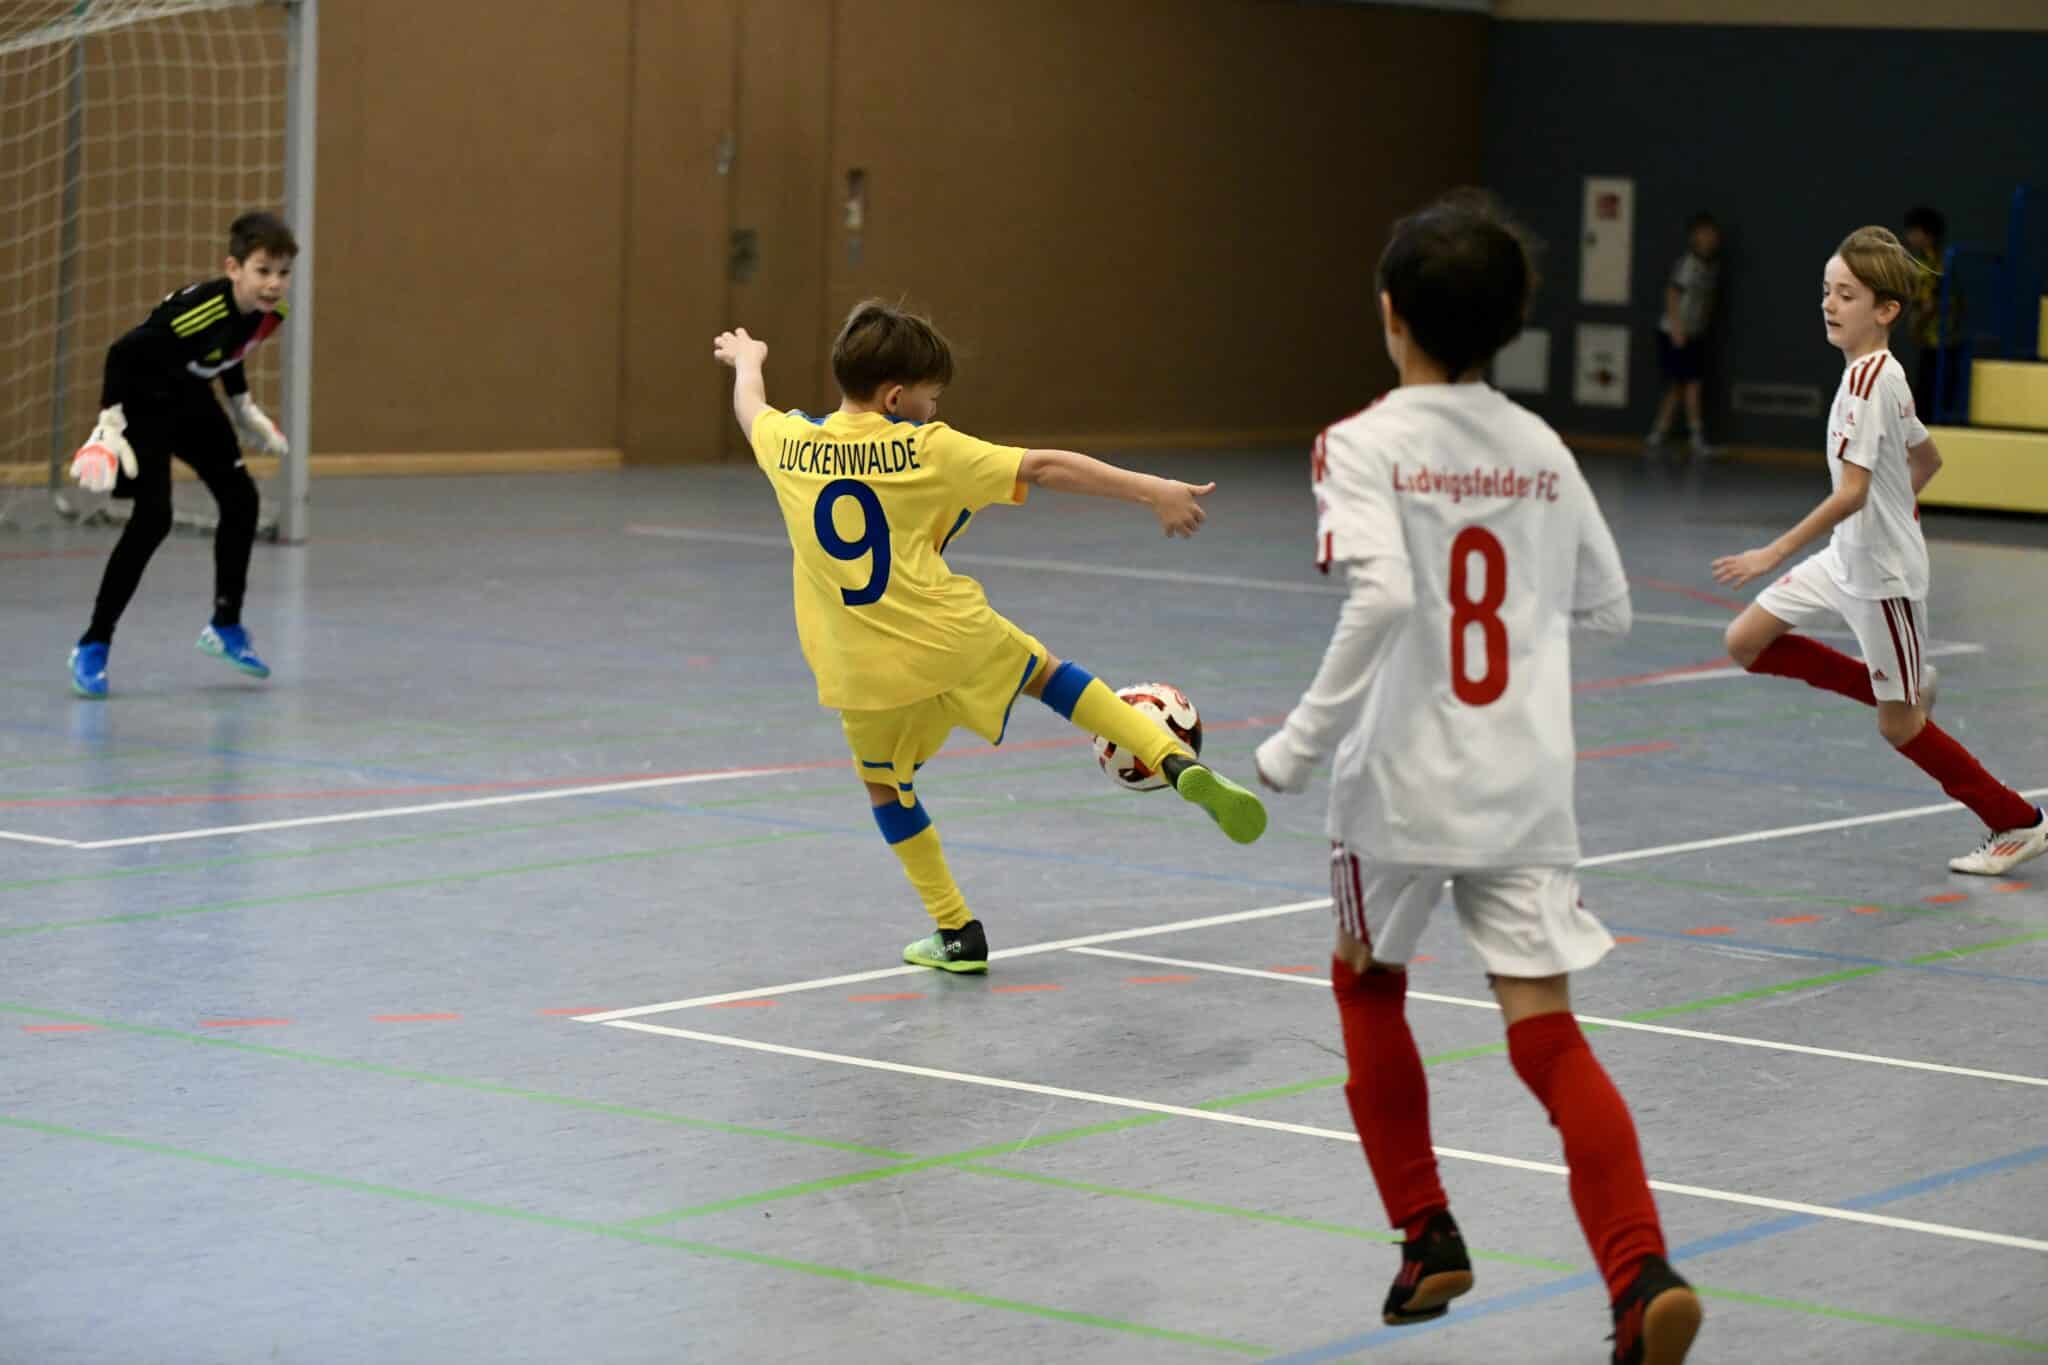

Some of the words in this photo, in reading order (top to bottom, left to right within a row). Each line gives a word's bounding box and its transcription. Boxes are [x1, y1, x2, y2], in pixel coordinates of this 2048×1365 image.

[779, 438, 920, 475] LUCKENWALDE
[1535, 470, 1559, 502] FC
[814, 478, 891, 606] 9
[1449, 525, 1509, 707] 8
